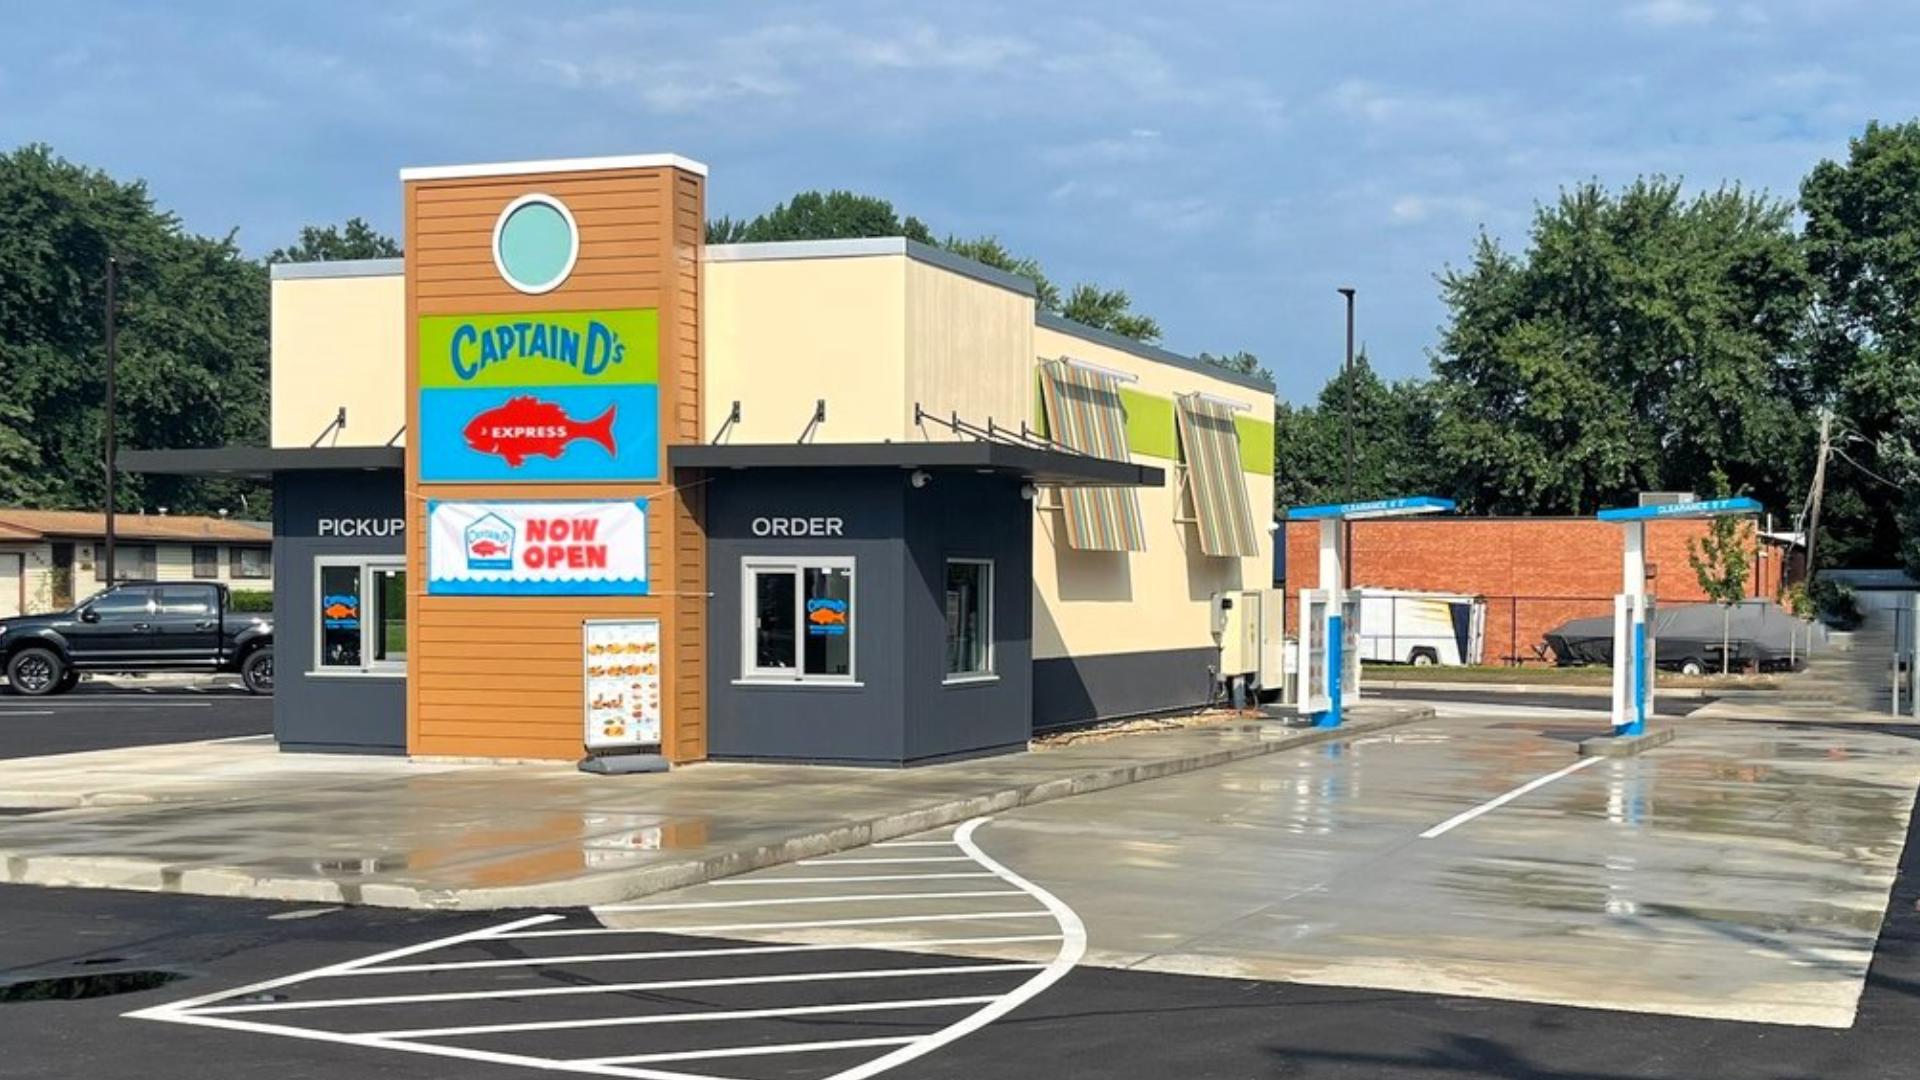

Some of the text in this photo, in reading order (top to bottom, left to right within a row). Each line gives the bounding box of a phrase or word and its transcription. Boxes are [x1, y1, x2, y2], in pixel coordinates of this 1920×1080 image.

[451, 322, 580, 380] CAPTAIN
[491, 425, 568, 439] EXPRESS
[318, 518, 405, 537] PICKUP
[525, 518, 599, 542] NOW
[751, 516, 844, 537] ORDER
[523, 545, 608, 570] OPEN
